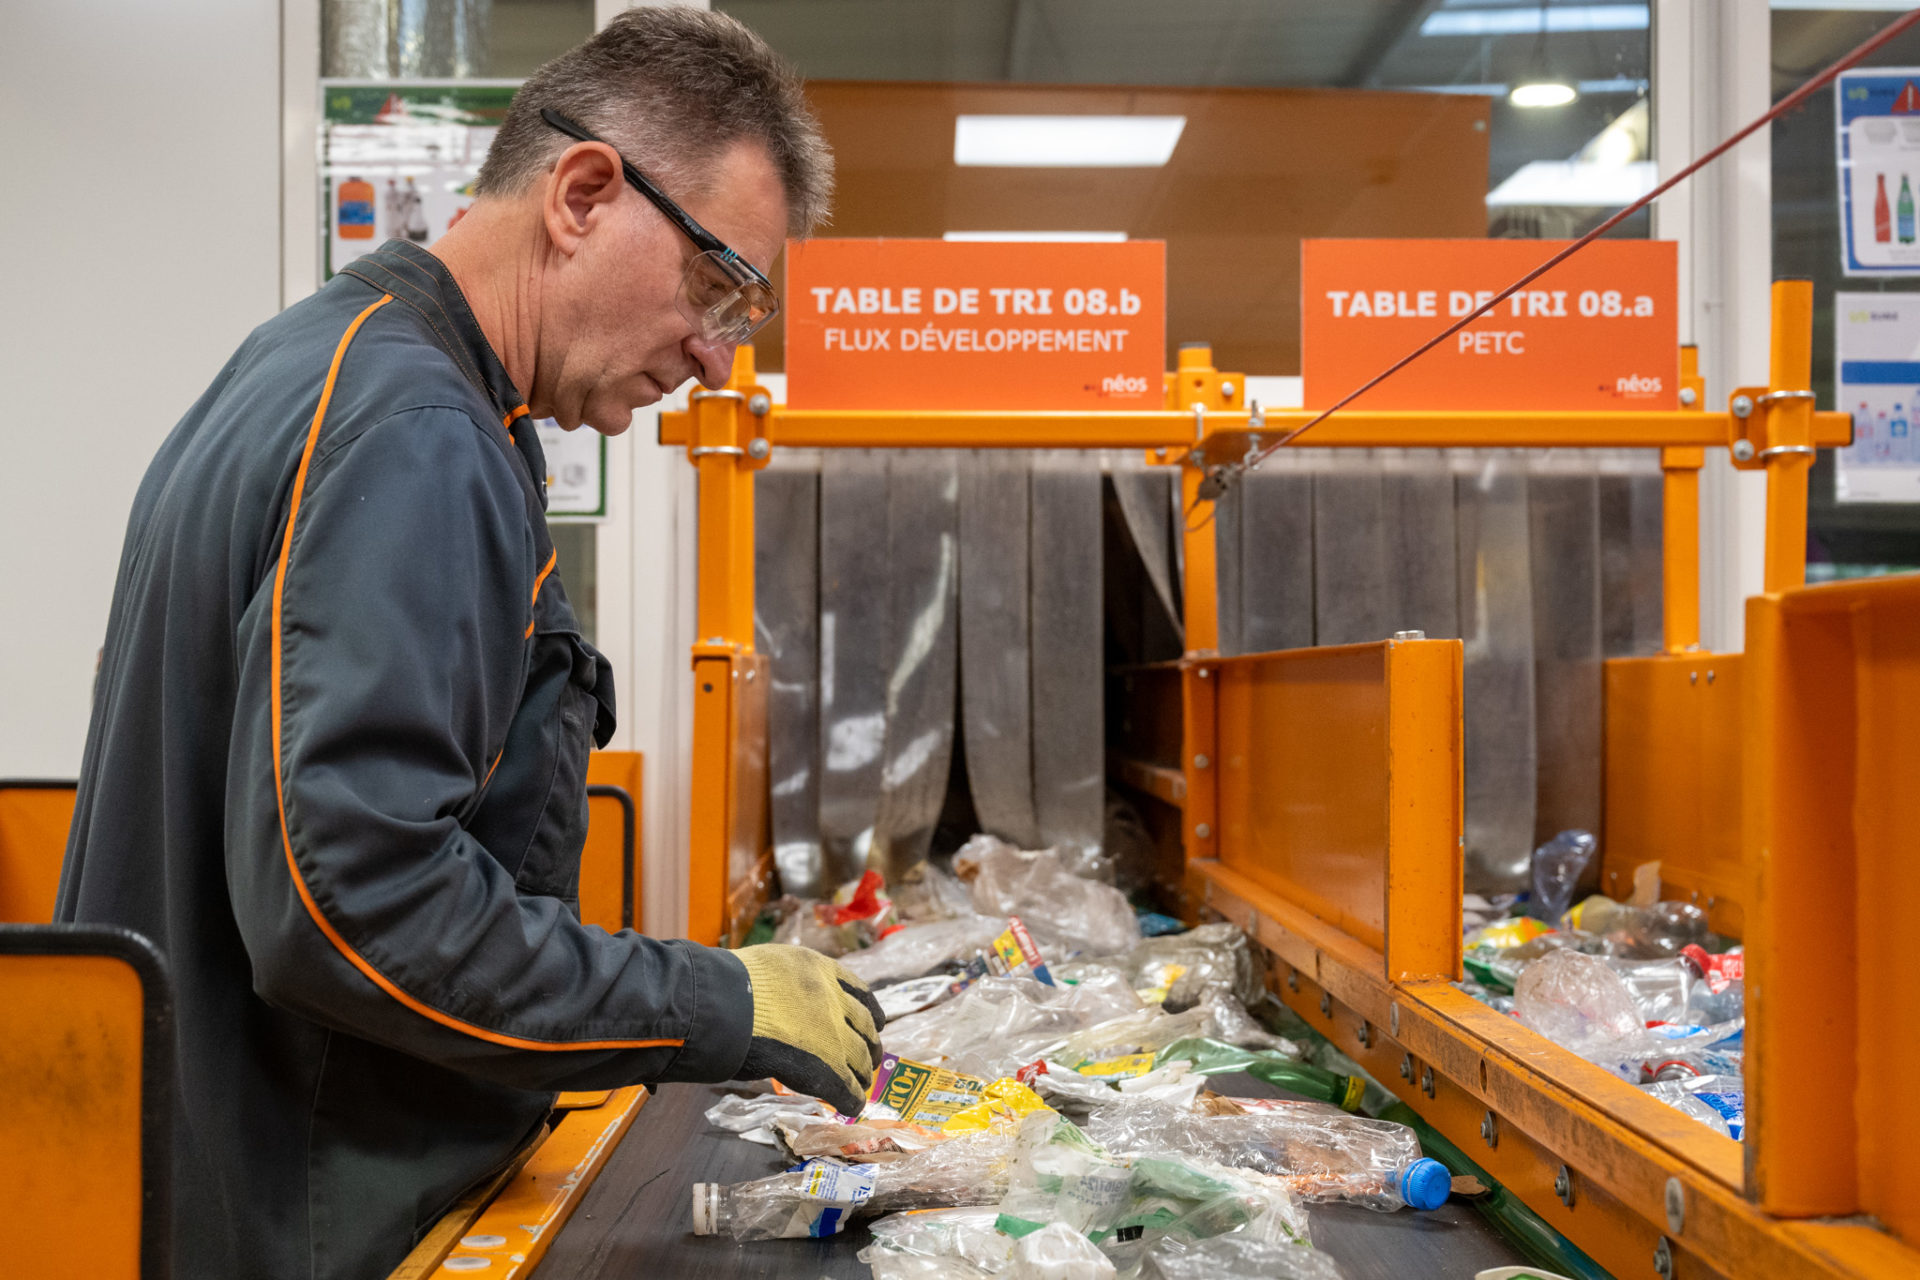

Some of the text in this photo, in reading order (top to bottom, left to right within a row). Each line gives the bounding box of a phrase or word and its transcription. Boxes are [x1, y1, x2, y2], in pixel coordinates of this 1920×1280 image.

[811, 287, 1142, 315] TABLE DE TRI 08.b
[1326, 291, 1654, 317] TABLE DE TRI 08.a
[824, 321, 1129, 352] FLUX DÉVELOPPEMENT
[1458, 331, 1525, 354] PETC
[1102, 374, 1148, 393] néos
[1616, 374, 1663, 393] néos
